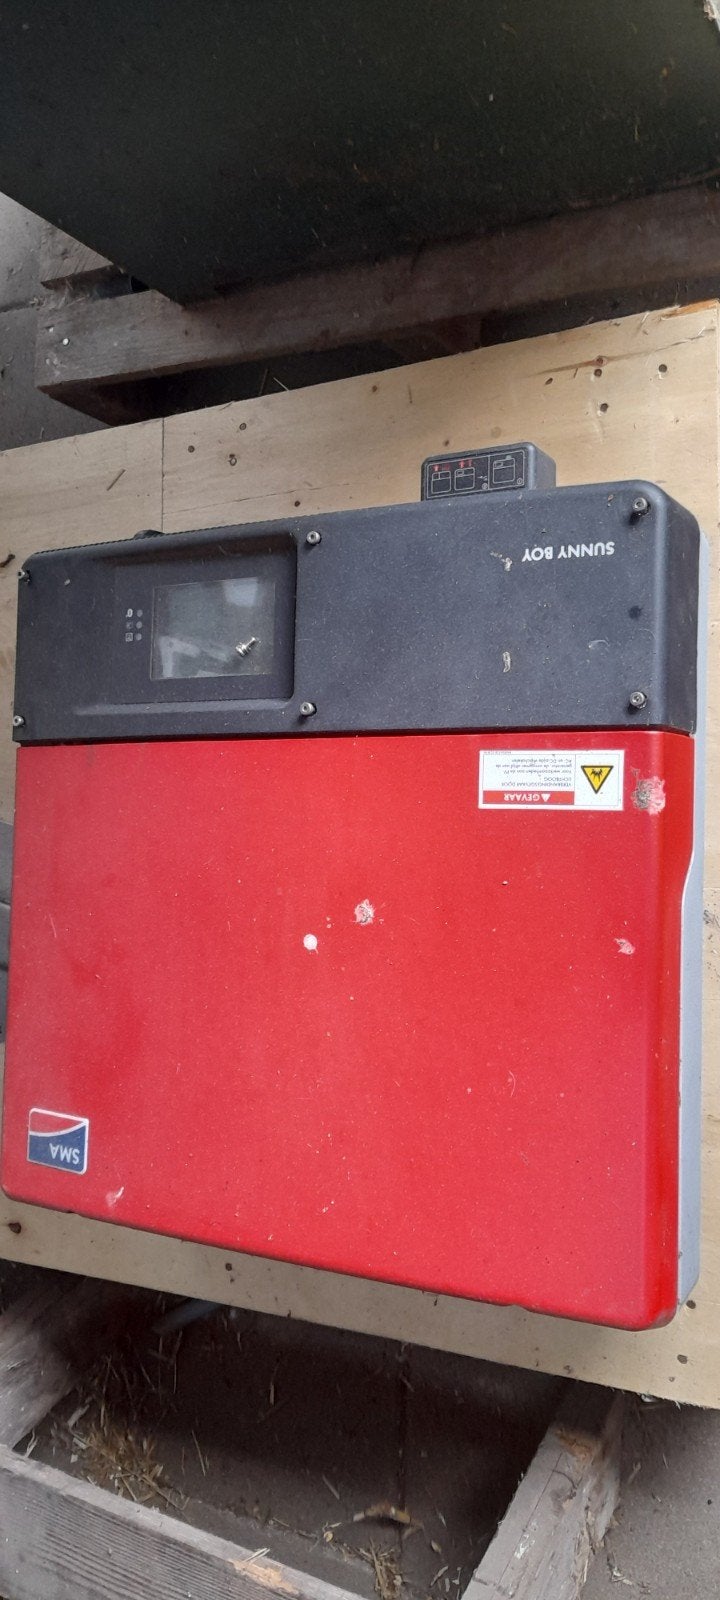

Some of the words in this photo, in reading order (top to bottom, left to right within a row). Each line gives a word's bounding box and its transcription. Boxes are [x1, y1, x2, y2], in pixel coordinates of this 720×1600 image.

[521, 546, 553, 562] BOY
[557, 541, 615, 559] SUNNY
[504, 793, 540, 802] GEVAAR
[49, 1142, 80, 1165] SMA
